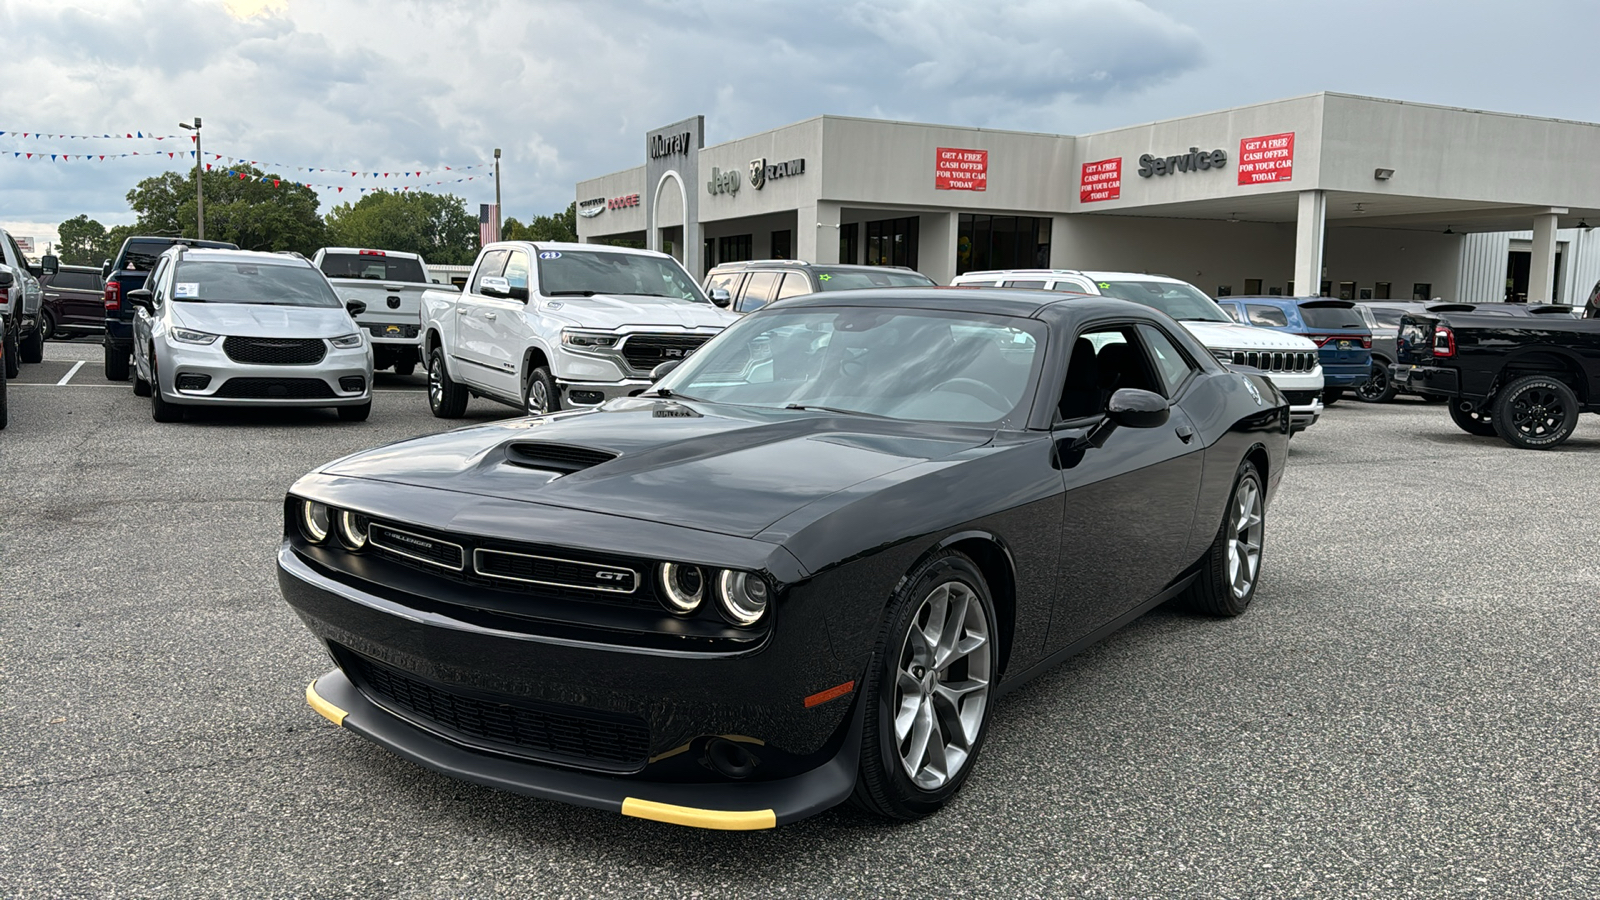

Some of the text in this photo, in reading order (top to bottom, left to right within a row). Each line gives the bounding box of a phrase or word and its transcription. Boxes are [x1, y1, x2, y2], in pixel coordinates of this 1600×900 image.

[651, 132, 690, 160] Murray
[1246, 137, 1288, 150] GET A FREE
[964, 153, 982, 161] FREE
[1243, 149, 1288, 161] CASH OFFER
[940, 161, 983, 170] CASH OFFER
[1086, 165, 1097, 173] GET
[1102, 162, 1117, 171] FREE
[1138, 147, 1227, 178] Service
[1239, 159, 1292, 173] FOR YOUR CAR
[764, 158, 804, 180] RAM
[936, 170, 986, 180] FOR YOUR CAR
[707, 167, 741, 197] Jeep
[1084, 171, 1117, 183] CASH OFFER
[1251, 172, 1277, 181] TODAY
[949, 180, 973, 188] TODAY
[1081, 180, 1120, 192] FOR YOUR CAR
[1090, 191, 1109, 200] TODAY
[607, 194, 640, 210] DODGE
[665, 348, 697, 357] RA
[384, 531, 432, 548] CHALLENGER
[595, 571, 630, 581] GT
